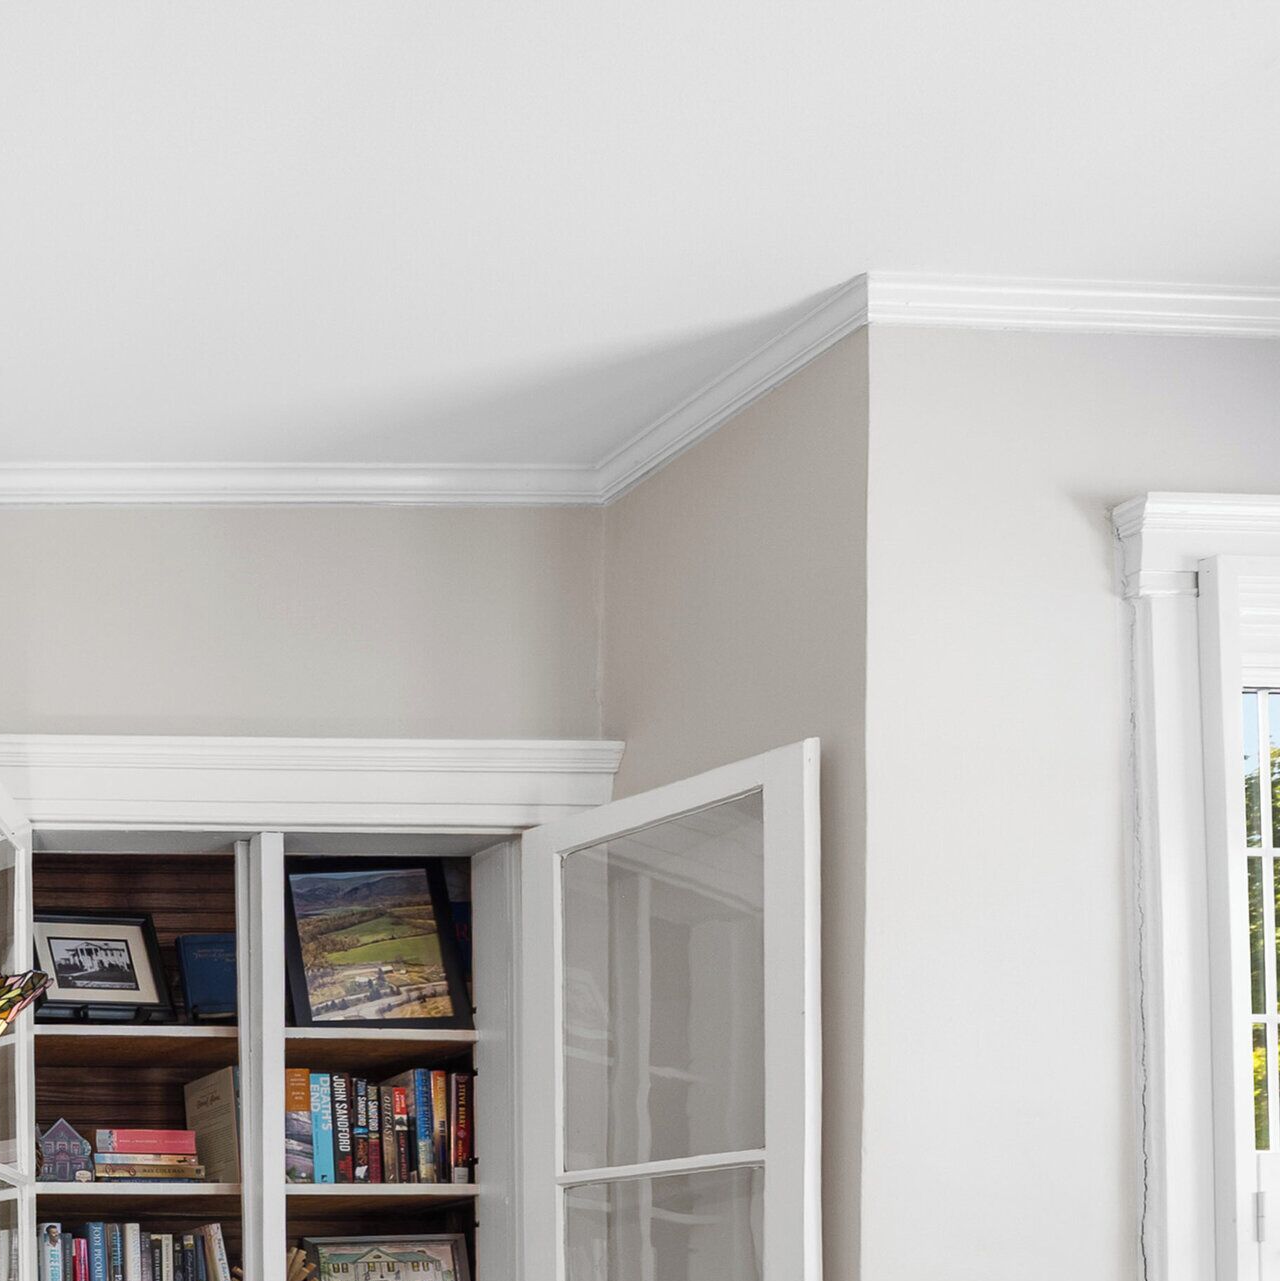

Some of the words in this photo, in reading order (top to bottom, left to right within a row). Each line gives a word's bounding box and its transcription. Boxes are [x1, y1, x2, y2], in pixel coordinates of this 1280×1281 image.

[310, 1084, 321, 1112] END
[332, 1075, 346, 1101] JOHN
[458, 1084, 466, 1105] STEVE
[319, 1076, 333, 1130] DEATH'S
[357, 1096, 367, 1127] SANDFORD
[368, 1100, 379, 1131] SANDFORD
[458, 1106, 466, 1129] BERRY
[335, 1103, 351, 1152] SANDFORD
[384, 1095, 394, 1143] OUTCAST
[92, 1225, 102, 1246] JODI
